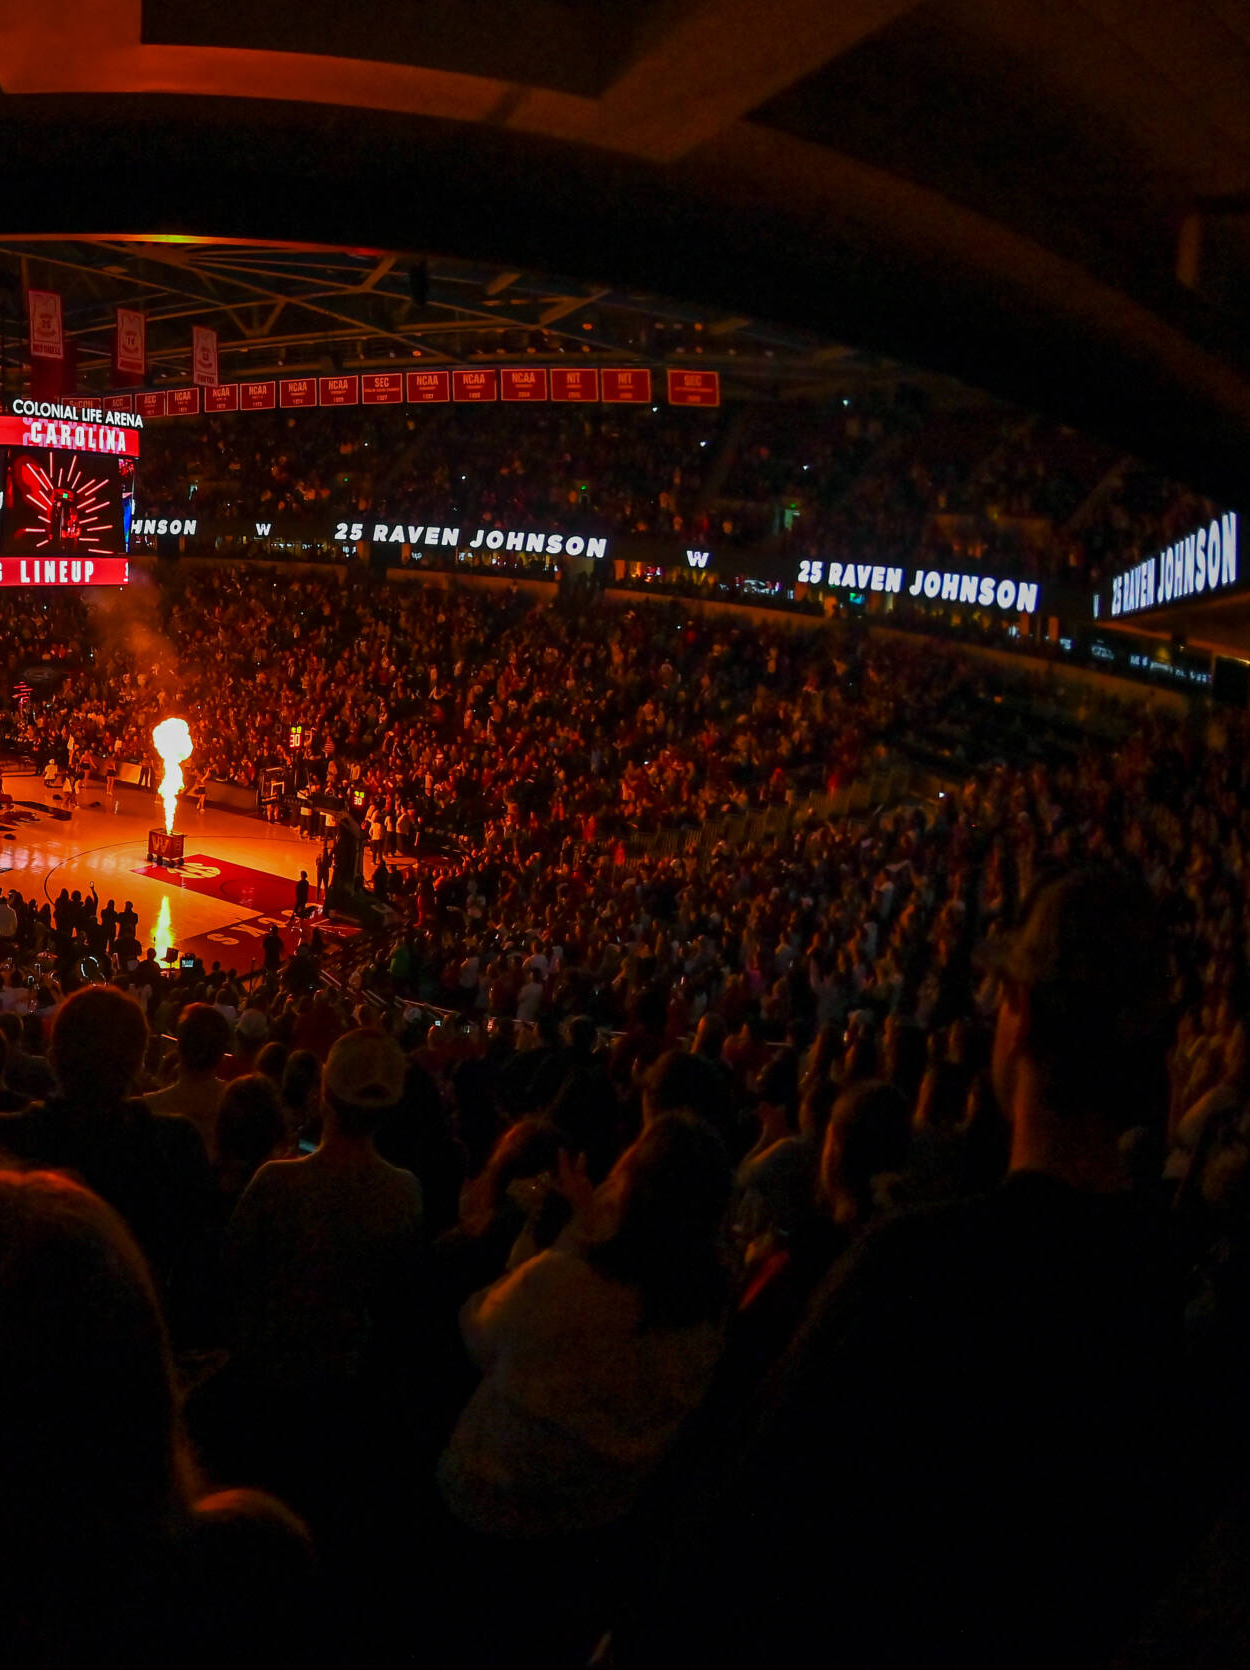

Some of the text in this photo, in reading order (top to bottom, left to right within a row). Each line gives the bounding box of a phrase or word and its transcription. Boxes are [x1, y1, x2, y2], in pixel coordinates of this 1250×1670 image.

[374, 377, 389, 388] SEC
[416, 375, 438, 385] NCAA
[463, 374, 485, 384] NCAA
[512, 372, 535, 383] NCAA
[249, 386, 267, 395] NCAA
[288, 382, 307, 392] NCAA
[329, 380, 348, 390] NCAA
[175, 391, 190, 401] NCAA
[213, 387, 230, 397] NCAA
[13, 398, 144, 428] COLONIAL LIFE ARENA
[30, 421, 126, 452] CAROLINA
[255, 523, 272, 537] W
[334, 522, 607, 558] 25 RAVEN JOHNSON
[686, 550, 710, 568] W
[1111, 511, 1238, 617] 25 RAVEN JOHNSON
[20, 560, 94, 584] LINEUP
[797, 560, 1039, 613] 25 RAVEN JOHNSON
[290, 734, 301, 748] 30
